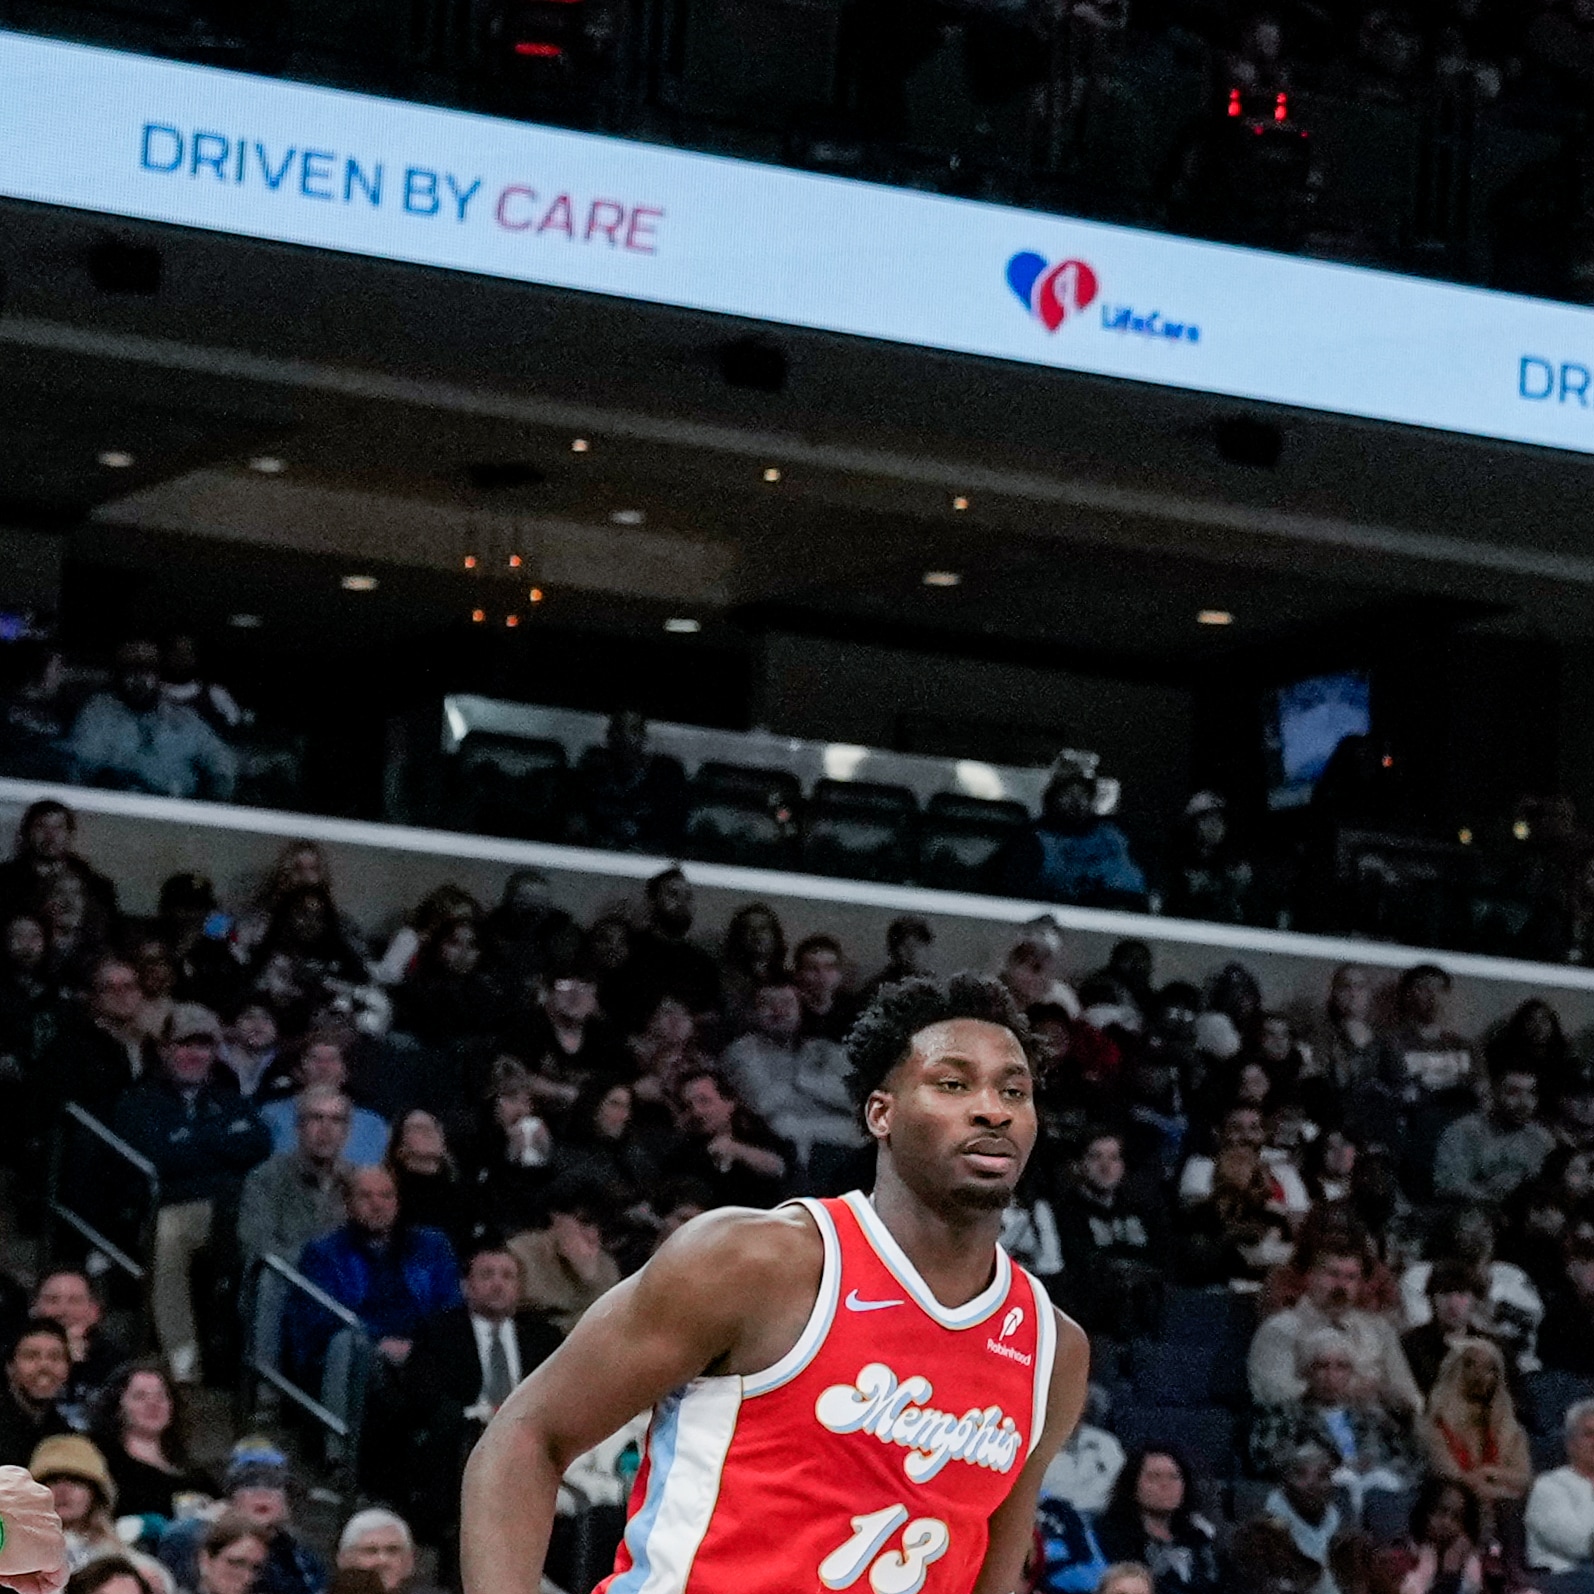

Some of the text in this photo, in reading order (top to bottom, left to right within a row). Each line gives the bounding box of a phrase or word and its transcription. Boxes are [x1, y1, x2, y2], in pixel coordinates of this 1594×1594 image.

[139, 121, 665, 255] DRIVEN BY CARE
[1101, 303, 1199, 342] LifeCare
[987, 1337, 1032, 1366] Robinhood
[815, 1362, 1022, 1483] Memphis
